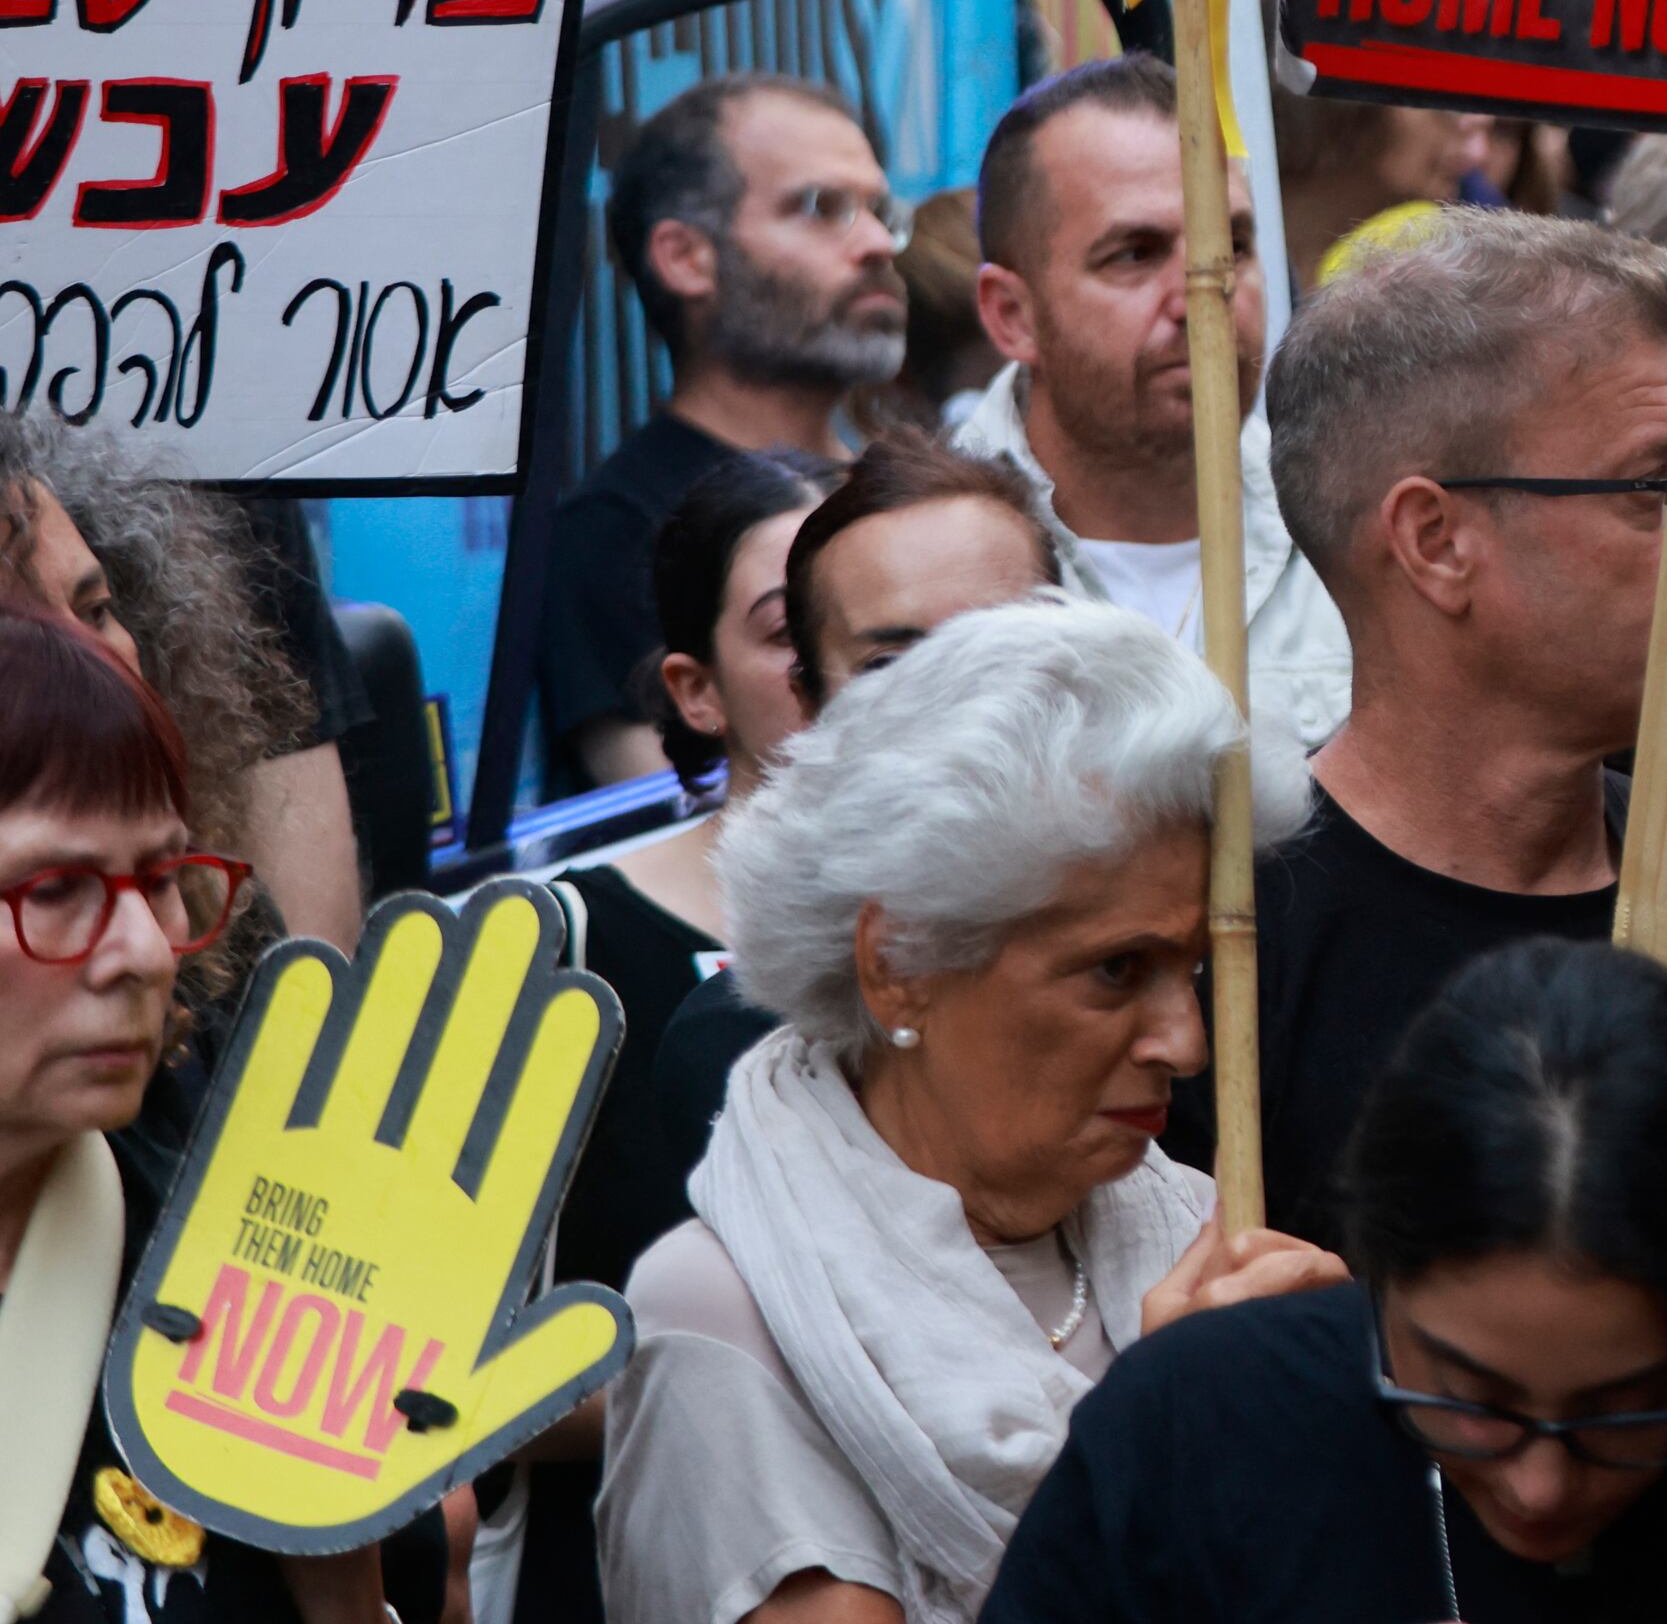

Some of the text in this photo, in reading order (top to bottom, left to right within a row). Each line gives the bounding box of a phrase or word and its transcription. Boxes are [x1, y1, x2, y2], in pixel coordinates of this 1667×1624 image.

[281, 277, 501, 423] אסור
[231, 1216, 381, 1305] THEM HOME
[245, 1174, 330, 1238] BRING
[177, 1261, 447, 1455] NOW
